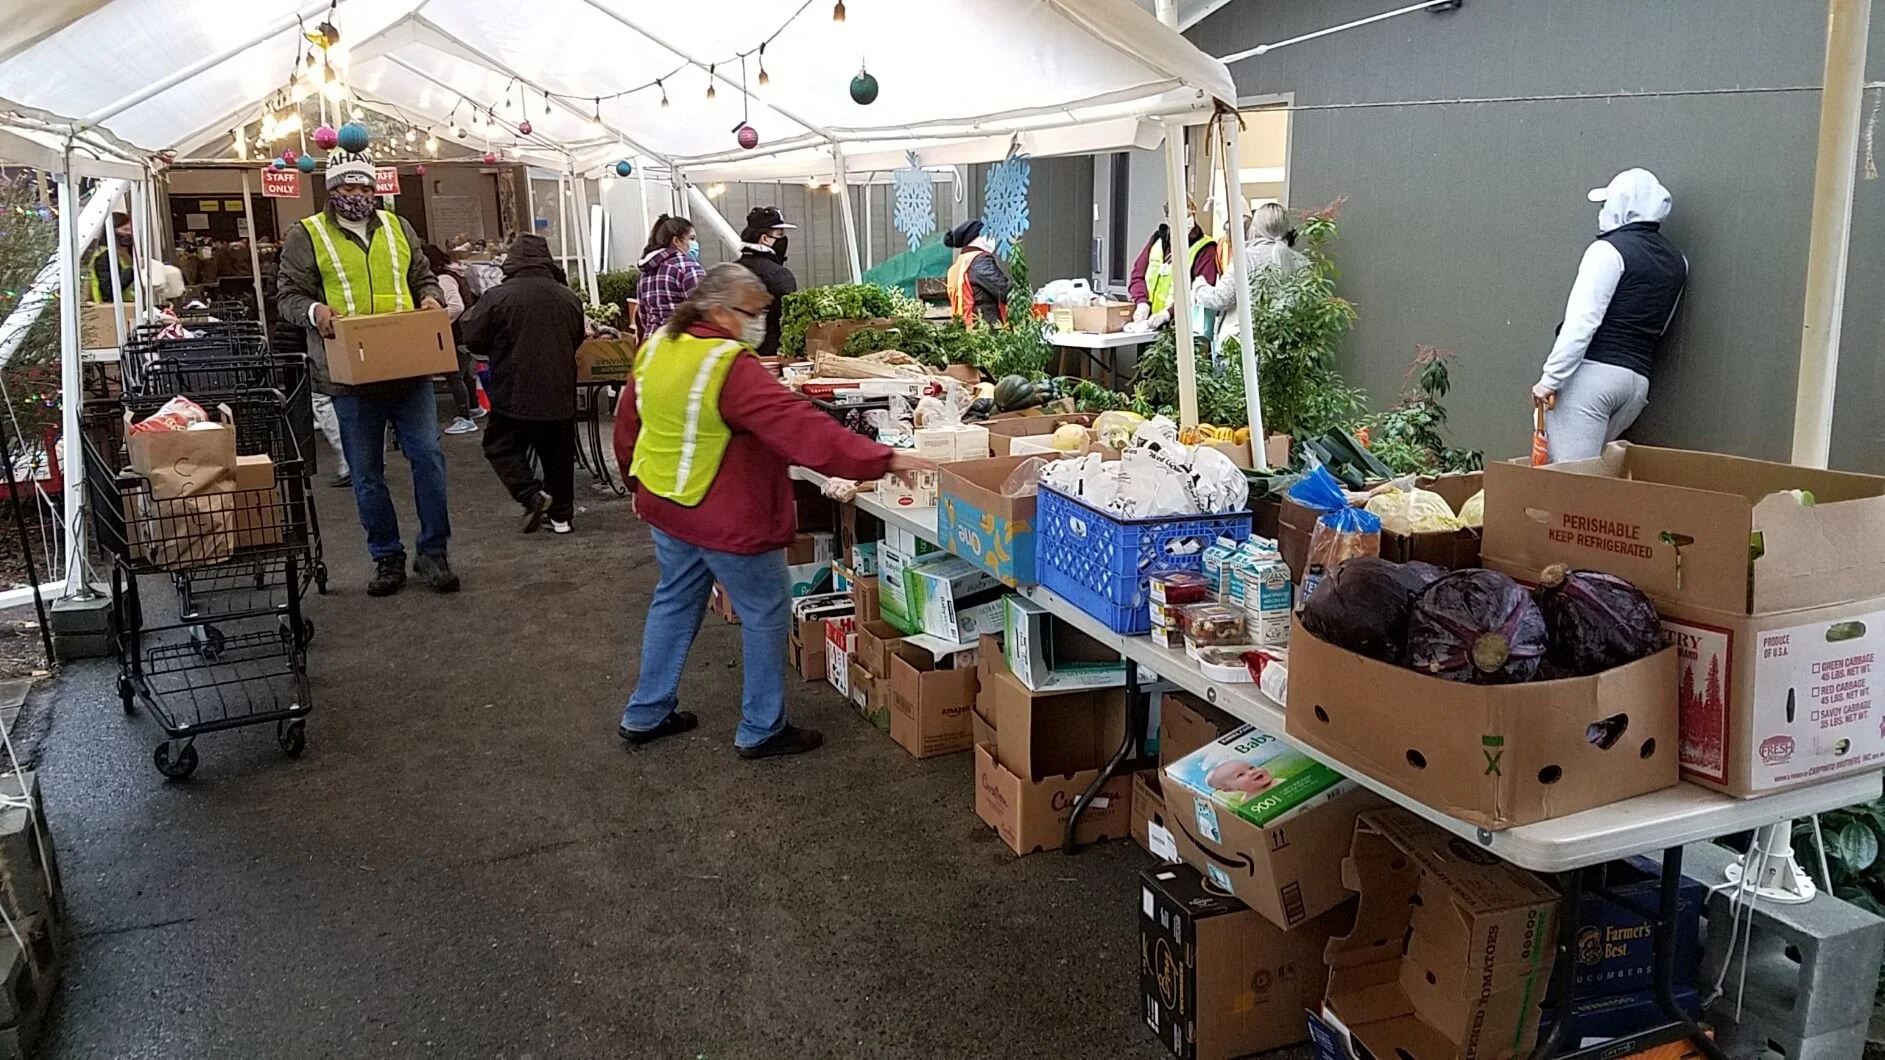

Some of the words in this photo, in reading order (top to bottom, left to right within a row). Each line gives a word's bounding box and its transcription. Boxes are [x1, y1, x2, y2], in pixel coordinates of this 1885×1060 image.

[266, 173, 295, 182] STAFF
[375, 172, 394, 180] AFF
[268, 185, 295, 193] ONLY
[375, 183, 394, 191] NLY
[1562, 513, 1641, 541] PERISHABLE
[1548, 528, 1575, 543] KEEP
[1576, 533, 1654, 559] REFRIGERATED
[1664, 629, 1703, 649] TRY
[1763, 634, 1791, 648] PRODUCE
[1677, 647, 1699, 661] RAND
[1764, 648, 1772, 659] OF
[1821, 659, 1844, 672] GREEN
[1845, 653, 1875, 668] CABBAGE
[1821, 672, 1831, 681] 45
[1846, 666, 1860, 677] NET
[1821, 684, 1835, 695] RED
[1836, 678, 1866, 693] CABBAGE
[1820, 696, 1830, 705] 45
[1846, 690, 1858, 700] NET
[942, 705, 971, 717] amazon
[1820, 706, 1842, 719] SAVOY
[1843, 700, 1873, 714] CABBAGE
[1819, 720, 1829, 729] 35
[1845, 713, 1858, 723] NET
[1234, 731, 1277, 755] Baby
[1761, 743, 1794, 757] FRESH
[1251, 797, 1277, 815] 900
[1606, 921, 1651, 942] Farmer's
[1604, 943, 1628, 959] Best
[1576, 965, 1653, 984] UCUMBERS
[1466, 1010, 1485, 1060] IPENED
[1479, 924, 1499, 1008] TOMATOES
